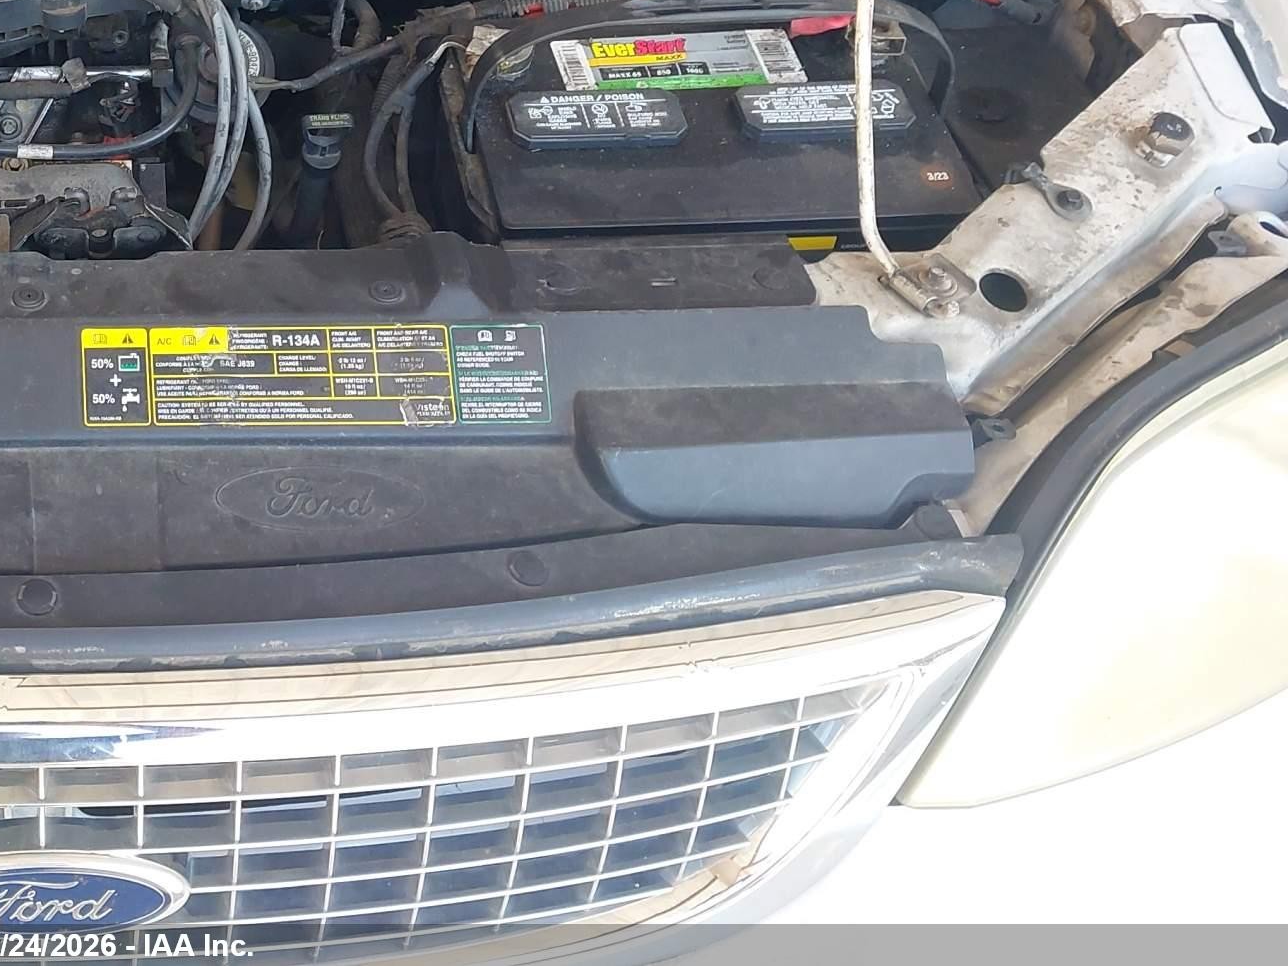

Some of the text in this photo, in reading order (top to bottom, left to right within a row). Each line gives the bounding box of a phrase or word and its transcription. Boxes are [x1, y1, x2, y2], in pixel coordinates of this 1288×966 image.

[591, 38, 686, 58] EverStart
[550, 94, 594, 103] DANGER
[604, 92, 644, 101] POISON
[157, 337, 172, 346] A/C
[272, 334, 320, 347] R-134A
[91, 358, 114, 369] 50%
[219, 360, 236, 368] SAE
[237, 360, 255, 368] J639
[92, 393, 116, 404] 50%
[266, 475, 375, 518] Ford
